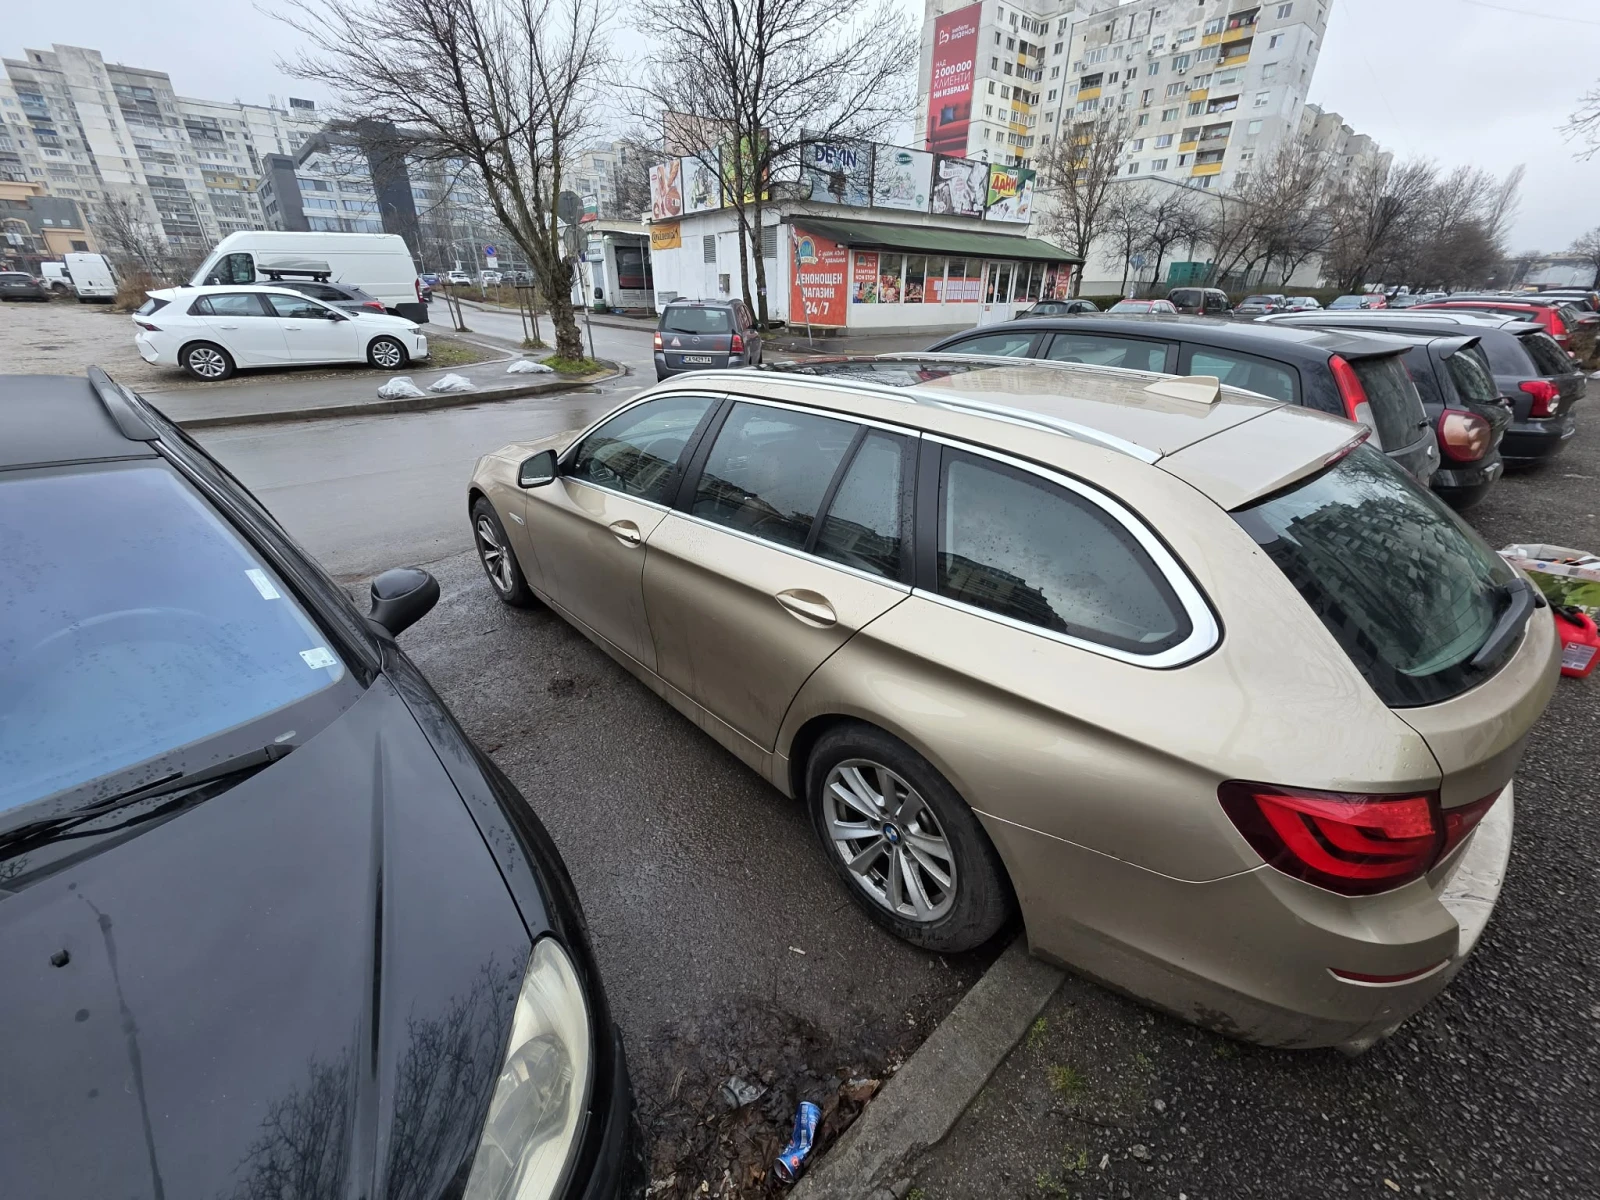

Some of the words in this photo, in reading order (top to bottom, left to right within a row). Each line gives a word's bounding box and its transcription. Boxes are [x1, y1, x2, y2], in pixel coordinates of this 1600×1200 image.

[933, 71, 971, 90] КЛИЕНТИ
[933, 90, 942, 99] НИ
[991, 174, 1018, 194] ДАНИ
[795, 273, 843, 286] ДЕНОНОЩЕН
[802, 287, 835, 298] МАГАЗИН
[805, 300, 830, 316] 24/7
